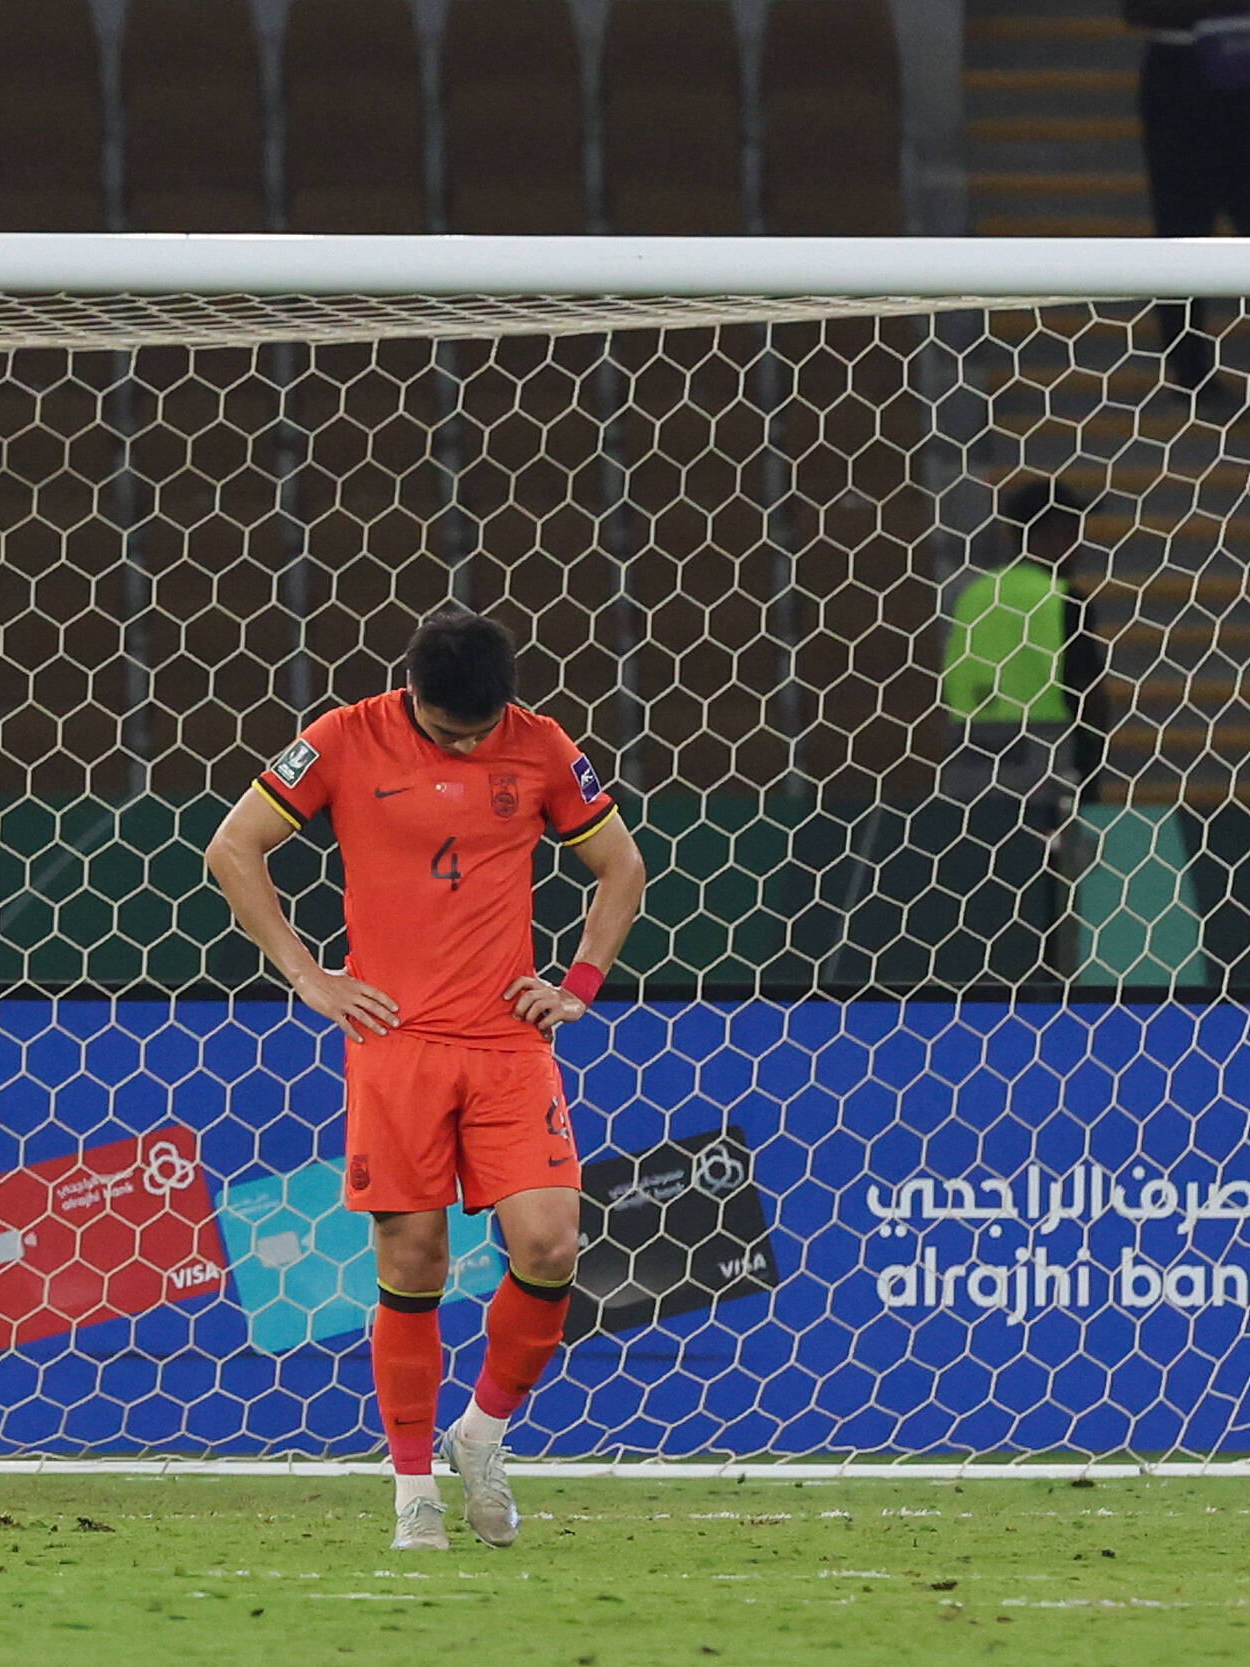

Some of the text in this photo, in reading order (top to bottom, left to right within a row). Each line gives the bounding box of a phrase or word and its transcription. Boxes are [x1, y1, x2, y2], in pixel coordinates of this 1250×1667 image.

[431, 836, 461, 891] 4
[866, 1164, 1250, 1239] صرف الراجحي
[169, 1261, 220, 1289] VISA
[876, 1246, 1248, 1326] alrajhi ban
